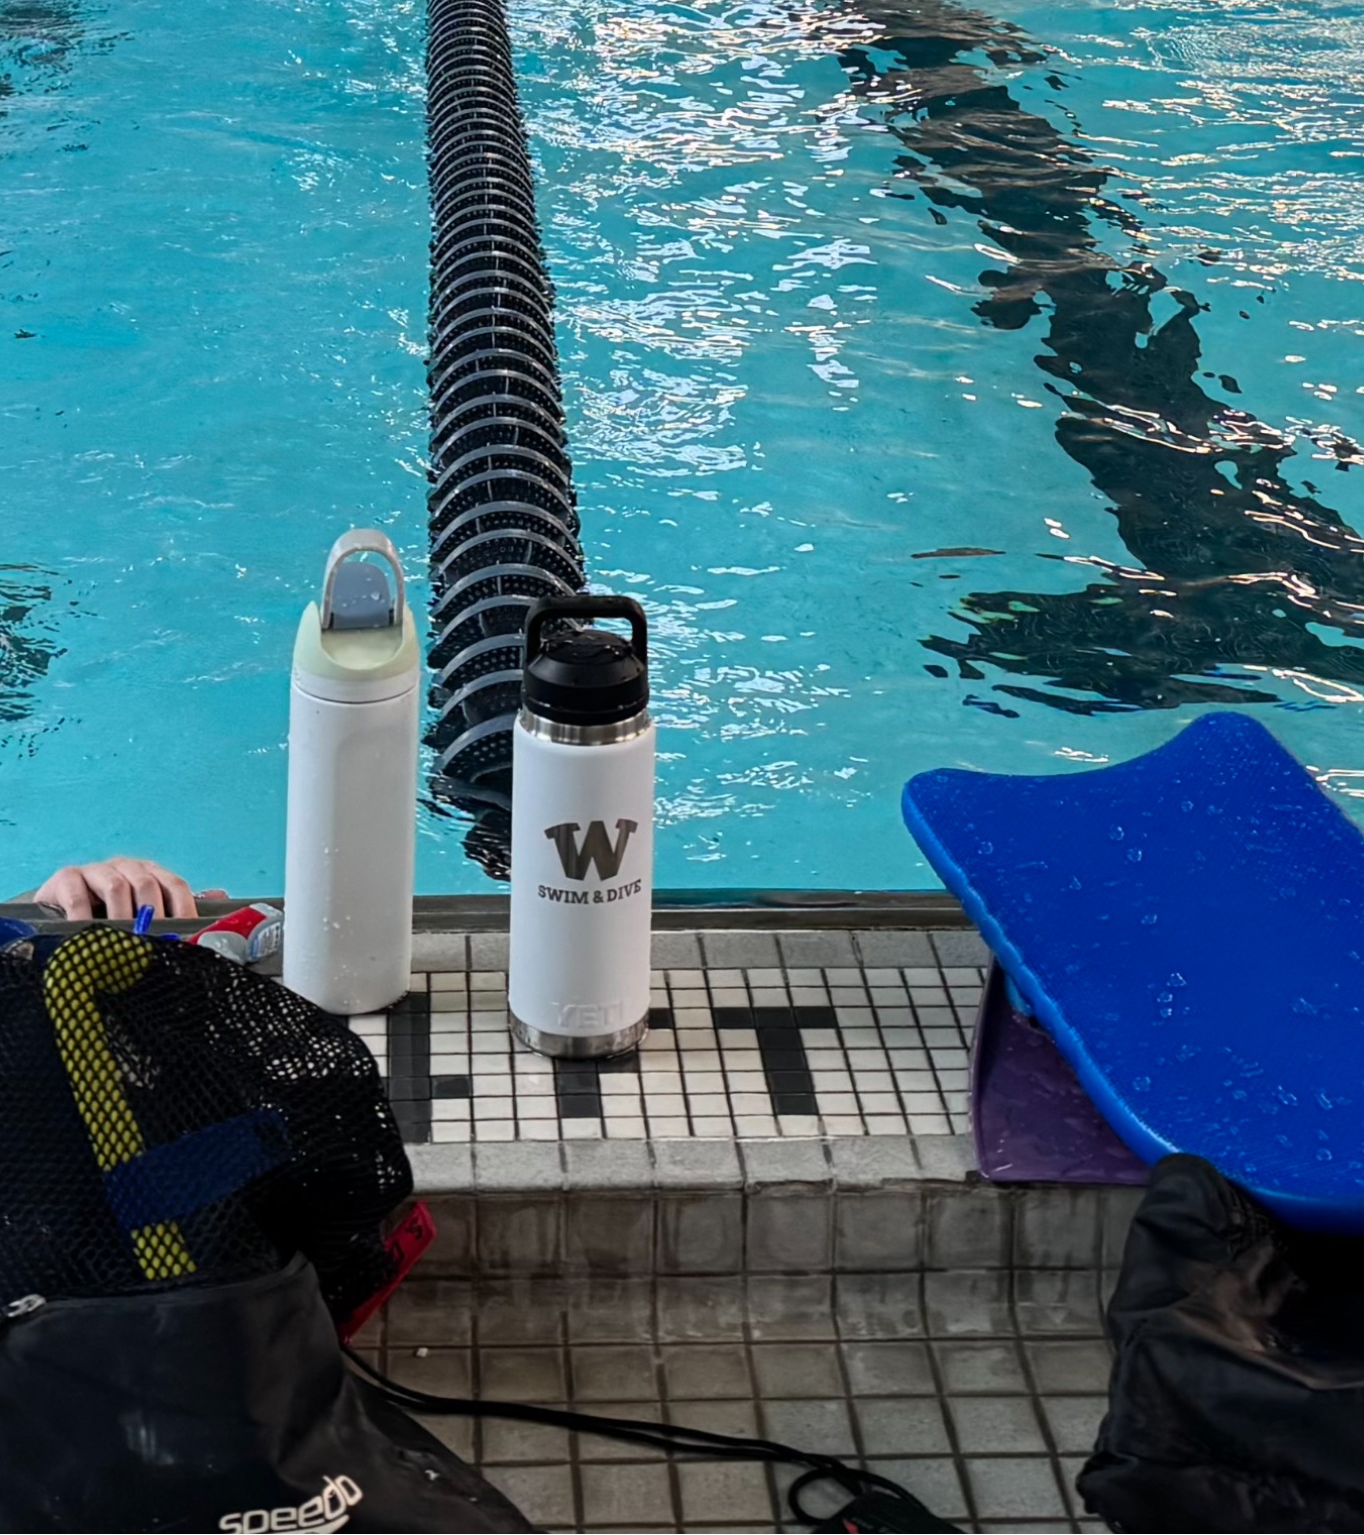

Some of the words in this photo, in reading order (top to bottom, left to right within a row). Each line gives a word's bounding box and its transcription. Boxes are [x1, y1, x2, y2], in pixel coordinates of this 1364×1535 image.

[544, 818, 638, 881] W
[537, 884, 589, 905] SWIM
[592, 889, 605, 904] &
[607, 879, 643, 903] DIVE
[550, 1000, 624, 1029] YETI
[219, 1474, 364, 1534] speedo
